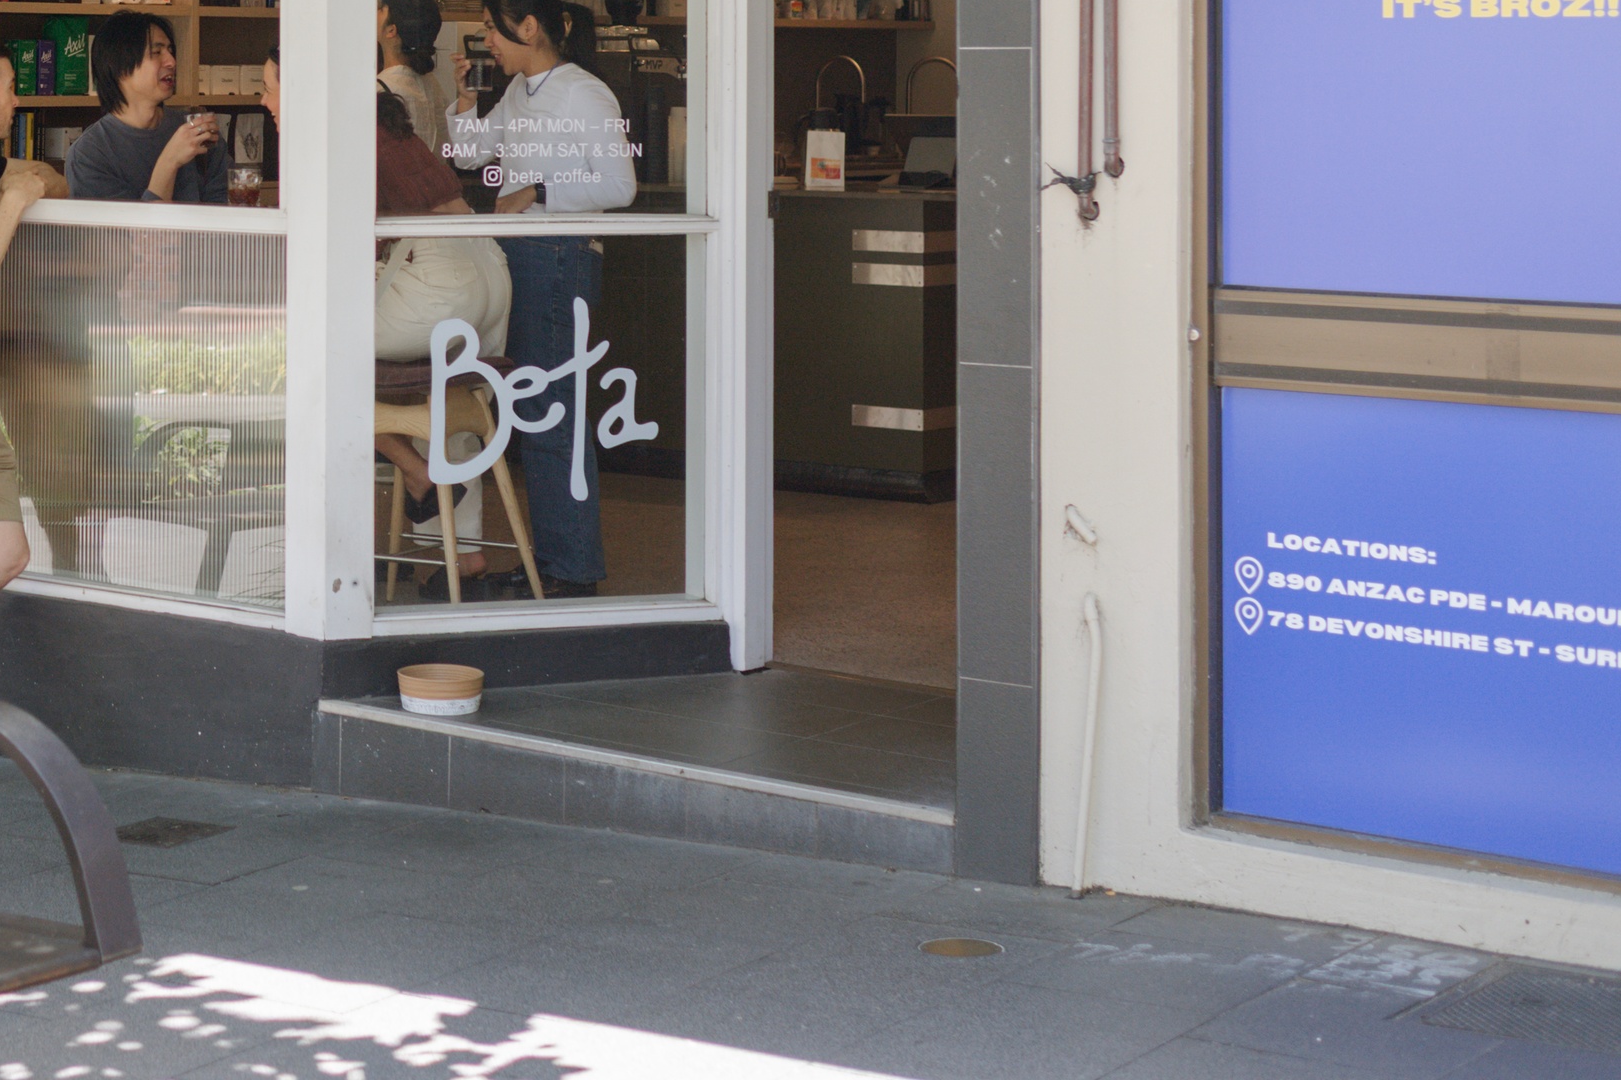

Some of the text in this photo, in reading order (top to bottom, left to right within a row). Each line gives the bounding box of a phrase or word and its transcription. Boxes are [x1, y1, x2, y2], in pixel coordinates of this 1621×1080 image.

[455, 119, 489, 133] 7AM
[507, 119, 542, 133] 4PM
[547, 119, 585, 133] MON
[604, 119, 630, 133] FRI
[442, 143, 477, 158] 8AM
[495, 143, 553, 158] 3:30PM
[557, 143, 588, 158] SAT
[592, 143, 604, 158] &
[608, 143, 643, 158] SUN
[509, 169, 602, 186] beta_coffee
[427, 296, 659, 502] Beta
[1267, 532, 1437, 565] LOCATIONS:
[1267, 571, 1322, 592] 890
[1326, 578, 1426, 604] ANZAC
[1430, 589, 1487, 611] PDE
[1507, 597, 1621, 626] MAROU
[1267, 610, 1305, 630] 78
[1308, 615, 1489, 653] DEVONSHIRE
[1493, 637, 1534, 657] ST
[1555, 644, 1621, 668] SUR
